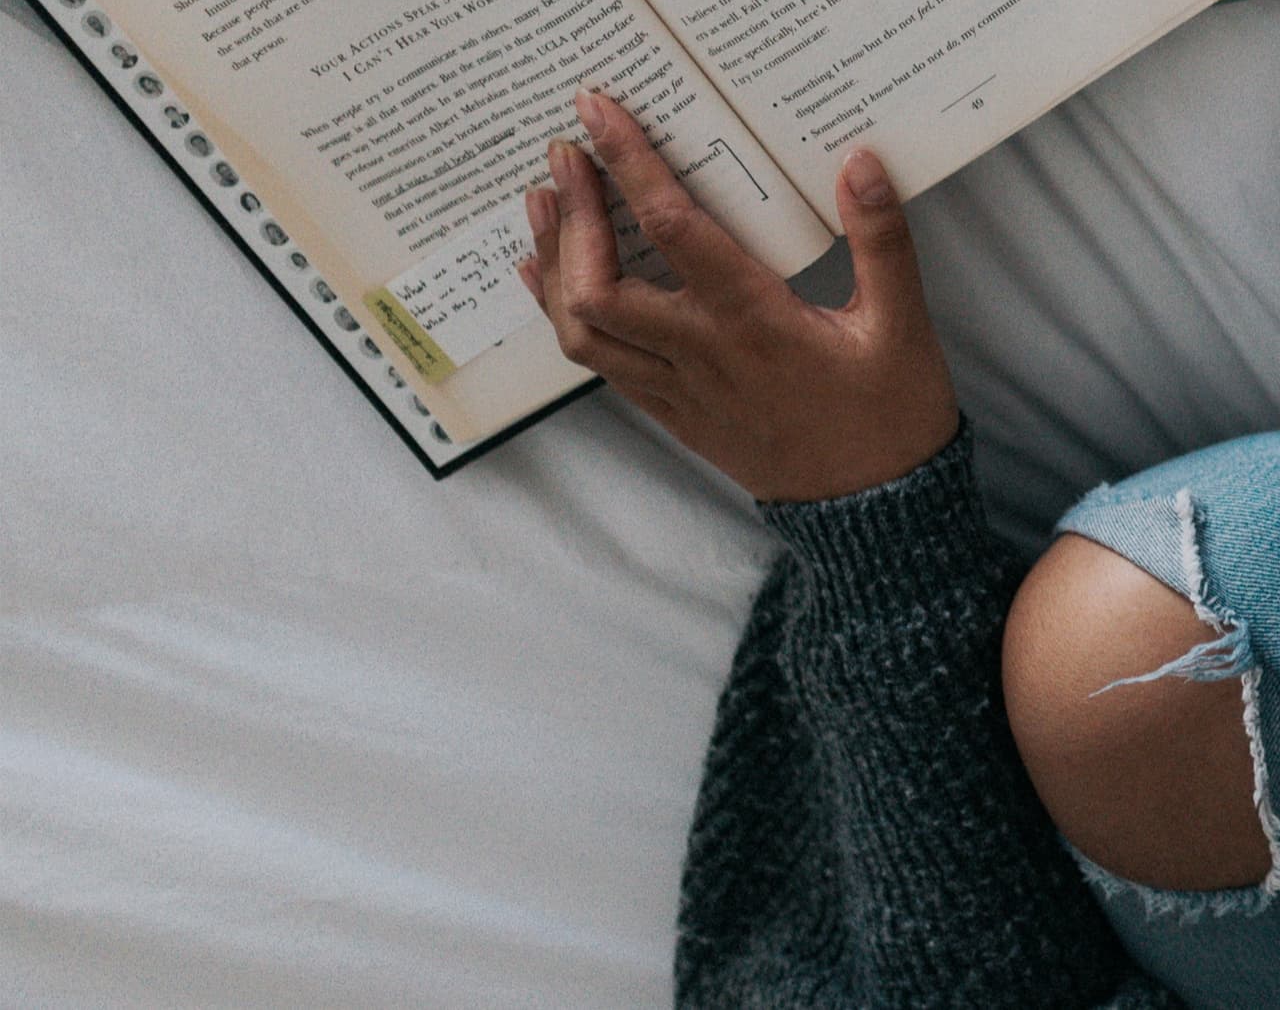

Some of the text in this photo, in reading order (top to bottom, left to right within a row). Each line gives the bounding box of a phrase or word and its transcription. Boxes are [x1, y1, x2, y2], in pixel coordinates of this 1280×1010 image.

[310, 53, 347, 77] YOUR
[349, 19, 403, 56] ACTIONS
[402, 0, 440, 22] SPEAK
[394, 27, 430, 50] HEAR
[429, 11, 463, 30] YOUR
[971, 98, 984, 110] 49
